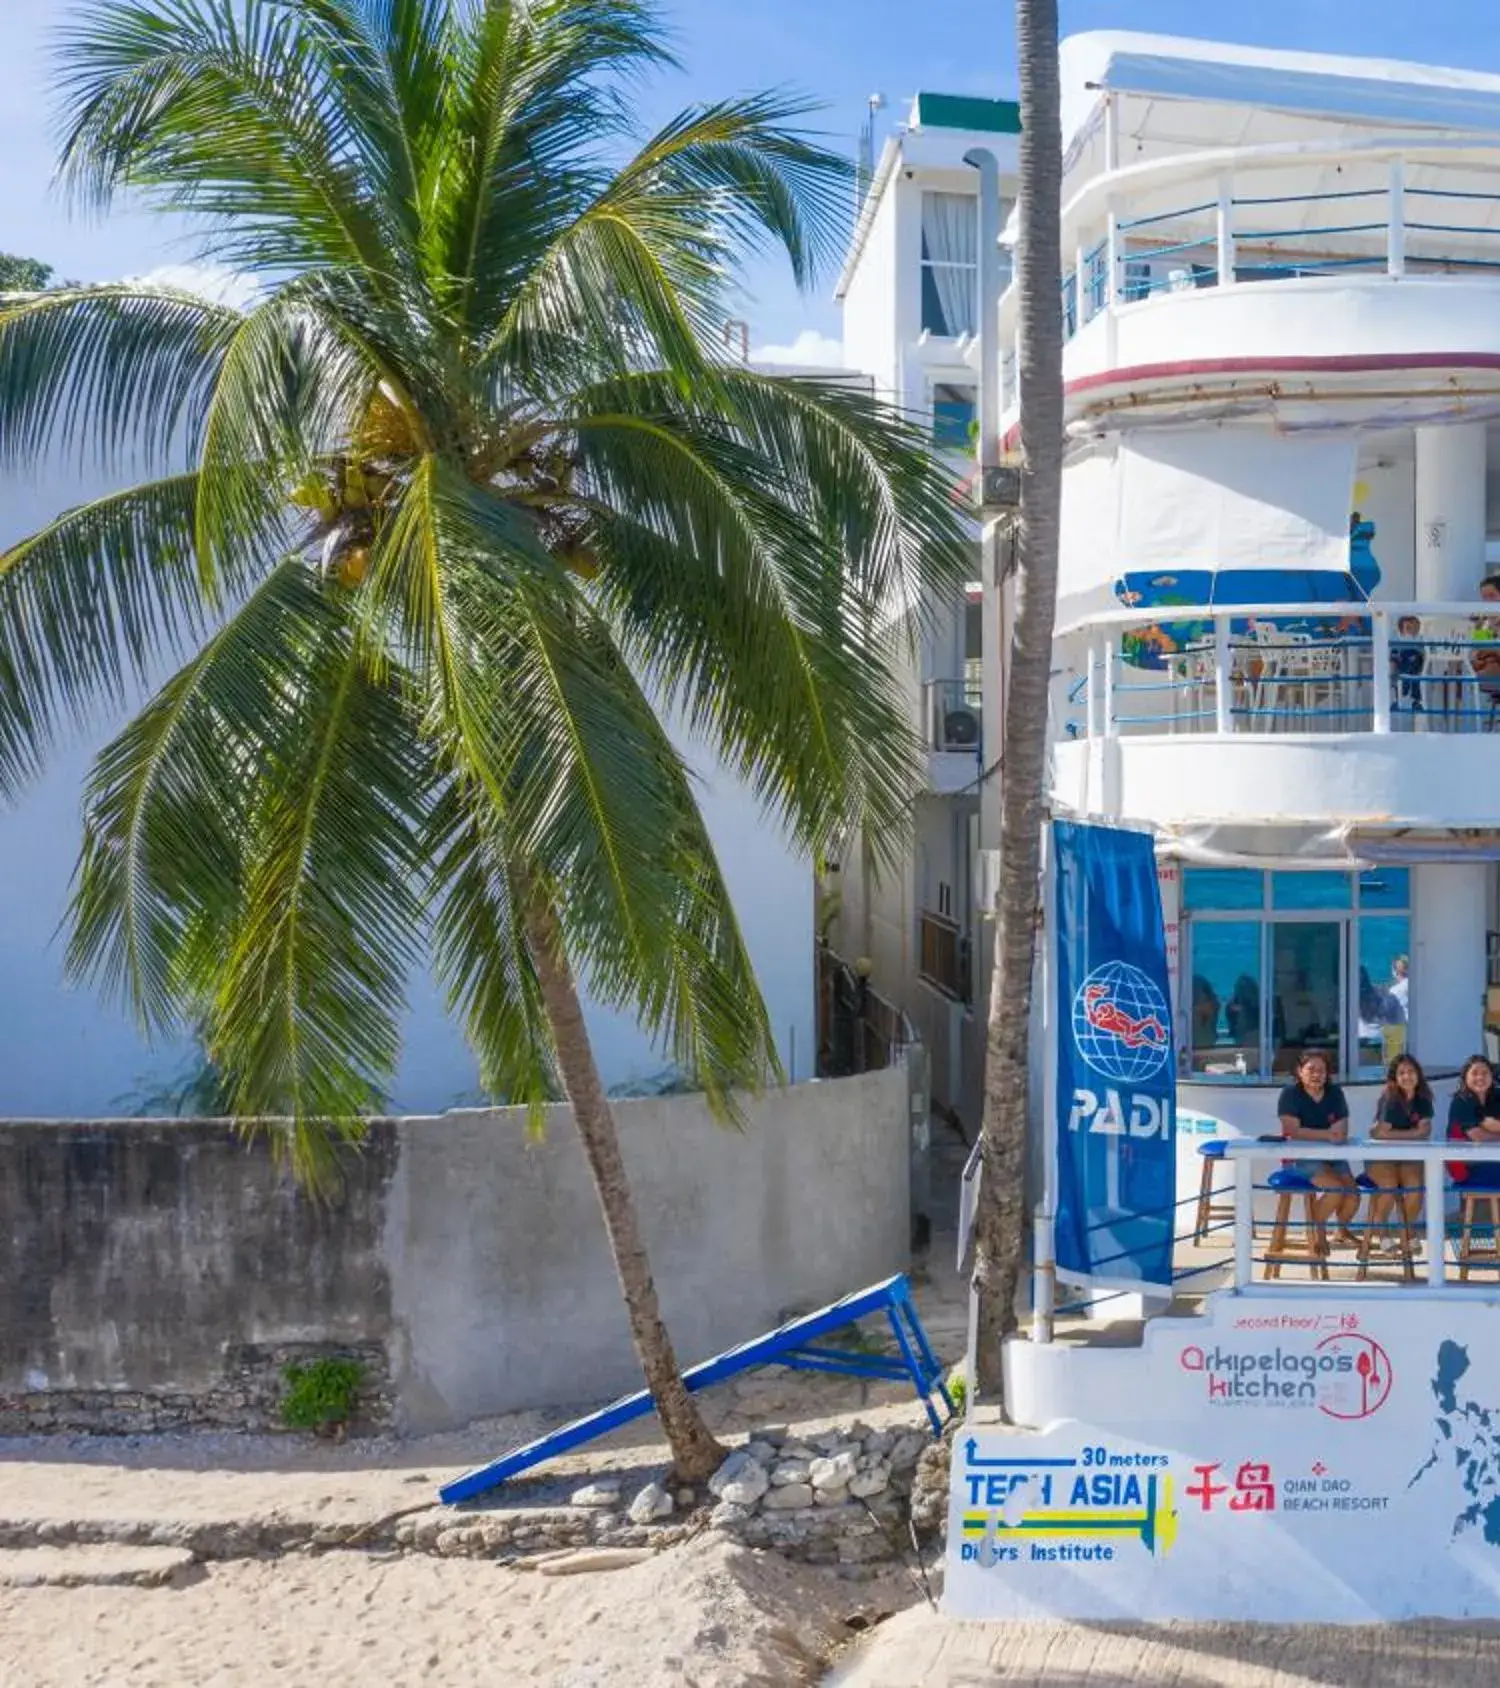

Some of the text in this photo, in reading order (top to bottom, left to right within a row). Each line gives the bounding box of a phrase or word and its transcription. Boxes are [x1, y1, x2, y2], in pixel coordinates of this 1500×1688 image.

[1068, 1087, 1169, 1141] PADI
[1181, 1346, 1353, 1379] arkipelagos
[1209, 1373, 1316, 1398] kitchen
[1082, 1447, 1169, 1467] 30 meters
[1069, 1474, 1143, 1505] ASIA
[1186, 1462, 1275, 1511] 千岛
[1284, 1479, 1351, 1494] QIAN DAO
[1283, 1496, 1389, 1511] BEACH RESORT
[961, 1543, 1114, 1561] Diers Institute
